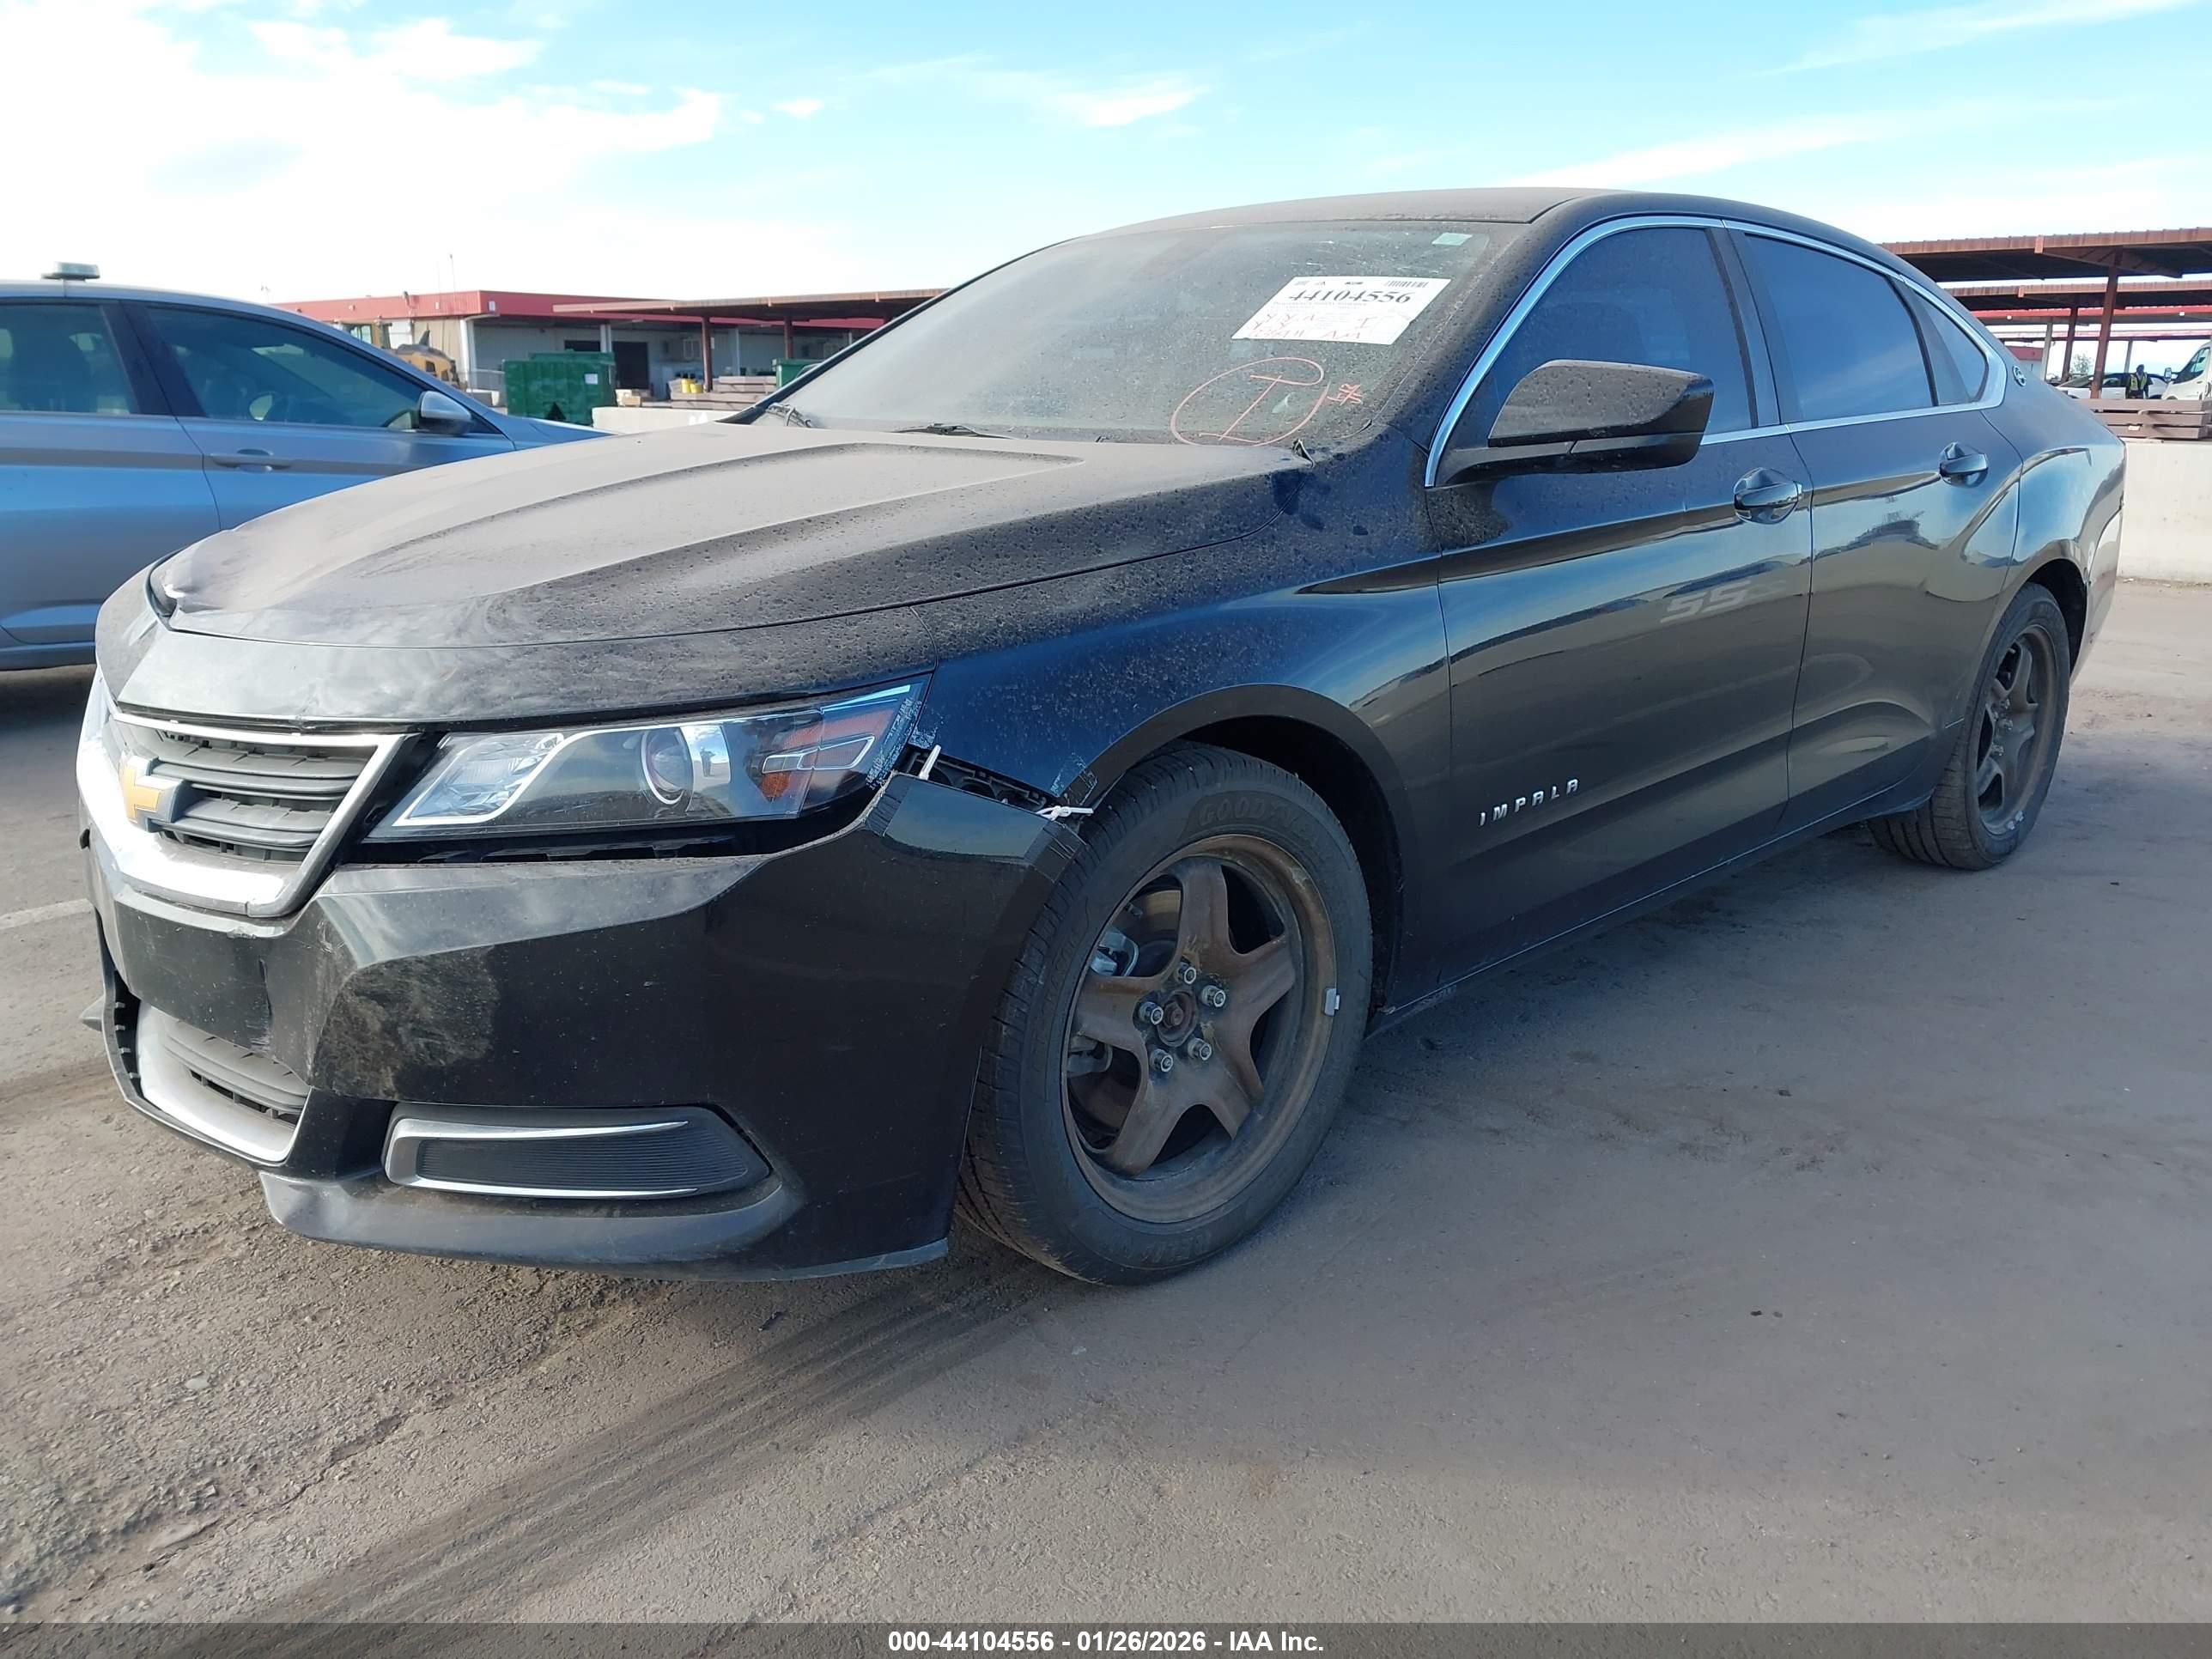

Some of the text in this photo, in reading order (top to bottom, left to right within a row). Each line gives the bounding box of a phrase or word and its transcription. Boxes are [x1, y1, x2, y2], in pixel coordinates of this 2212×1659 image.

[1288, 289, 1416, 304] 44104556
[1660, 580, 1753, 623] SS
[1479, 778, 1579, 826] IMPALA
